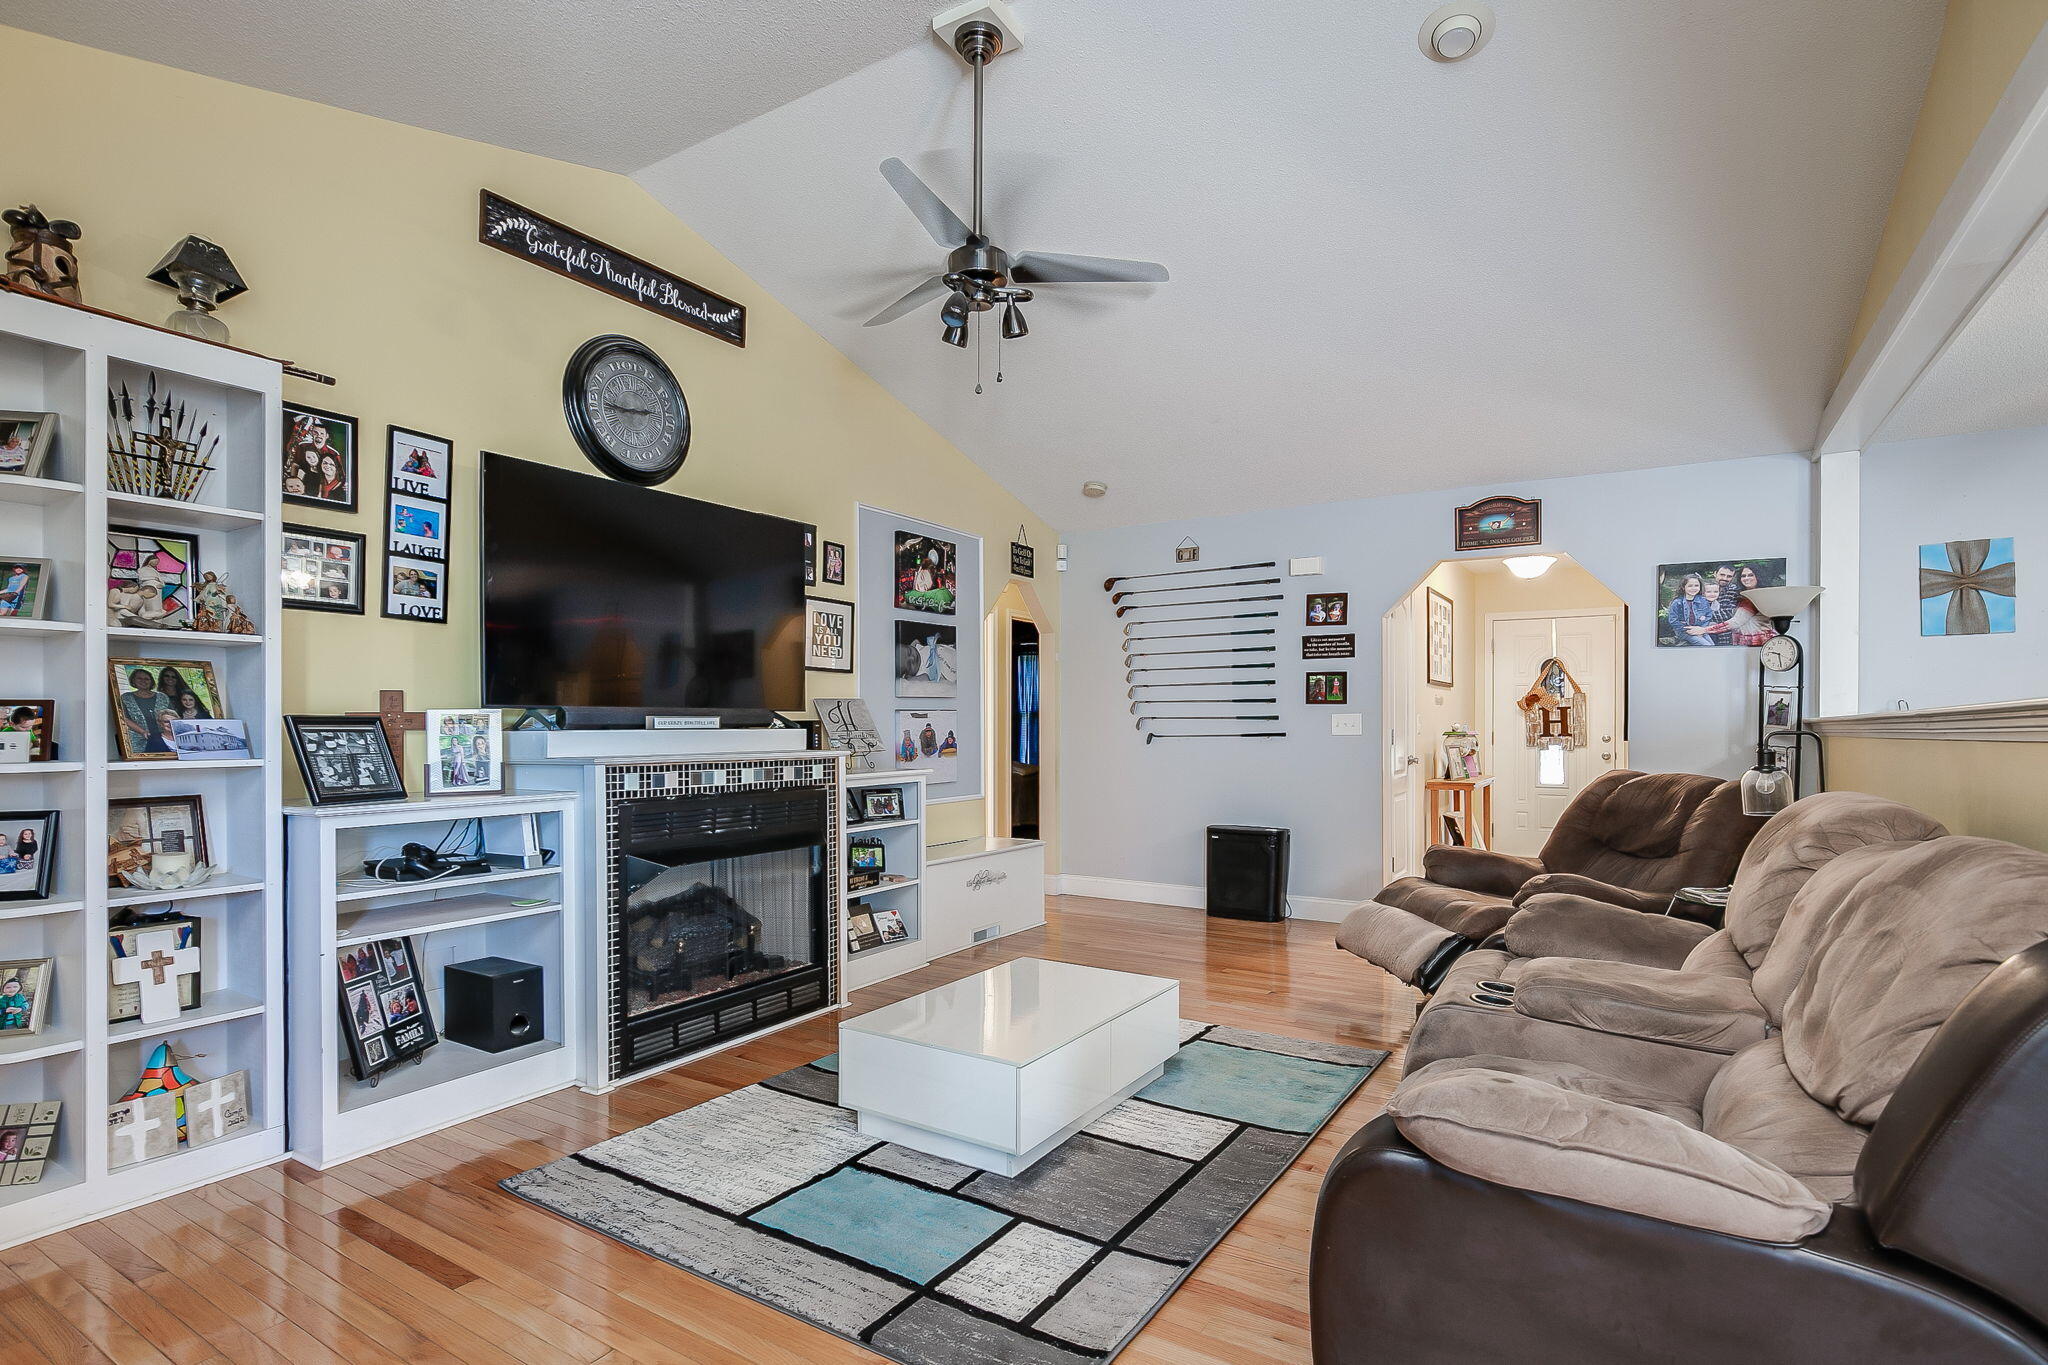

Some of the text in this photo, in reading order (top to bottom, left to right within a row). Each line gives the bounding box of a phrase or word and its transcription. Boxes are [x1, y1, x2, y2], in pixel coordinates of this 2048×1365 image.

[526, 227, 707, 320] Grateful Thankful Blessed
[608, 360, 656, 383] HOPE
[657, 386, 676, 447] FAITH
[620, 447, 664, 462] LOVE
[393, 476, 430, 496] LIVE
[393, 540, 442, 560] LAUGH
[400, 602, 442, 620] LOVE
[812, 611, 843, 630] LOVE
[814, 633, 841, 647] YOU
[816, 626, 839, 636] IS ALL
[812, 645, 844, 659] NEED
[1538, 706, 1573, 738] H
[851, 836, 882, 845] Laugh
[394, 1025, 424, 1047] FAMILY
[109, 1108, 131, 1118] amp
